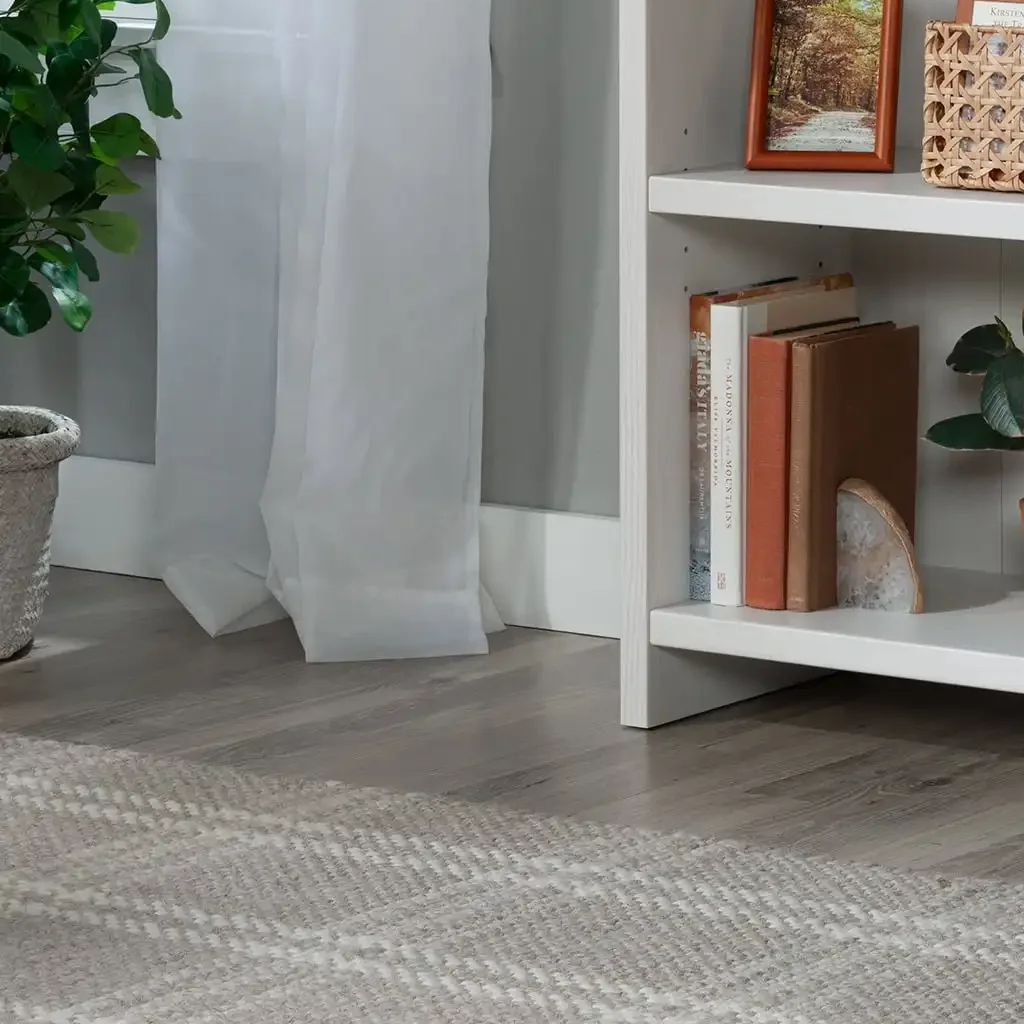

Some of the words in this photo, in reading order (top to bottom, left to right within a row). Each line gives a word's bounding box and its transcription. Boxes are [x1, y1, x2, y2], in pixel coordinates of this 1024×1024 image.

[696, 401, 708, 453] ITALY
[725, 374, 733, 432] MADONNA
[725, 459, 733, 530] MOUNTAINS
